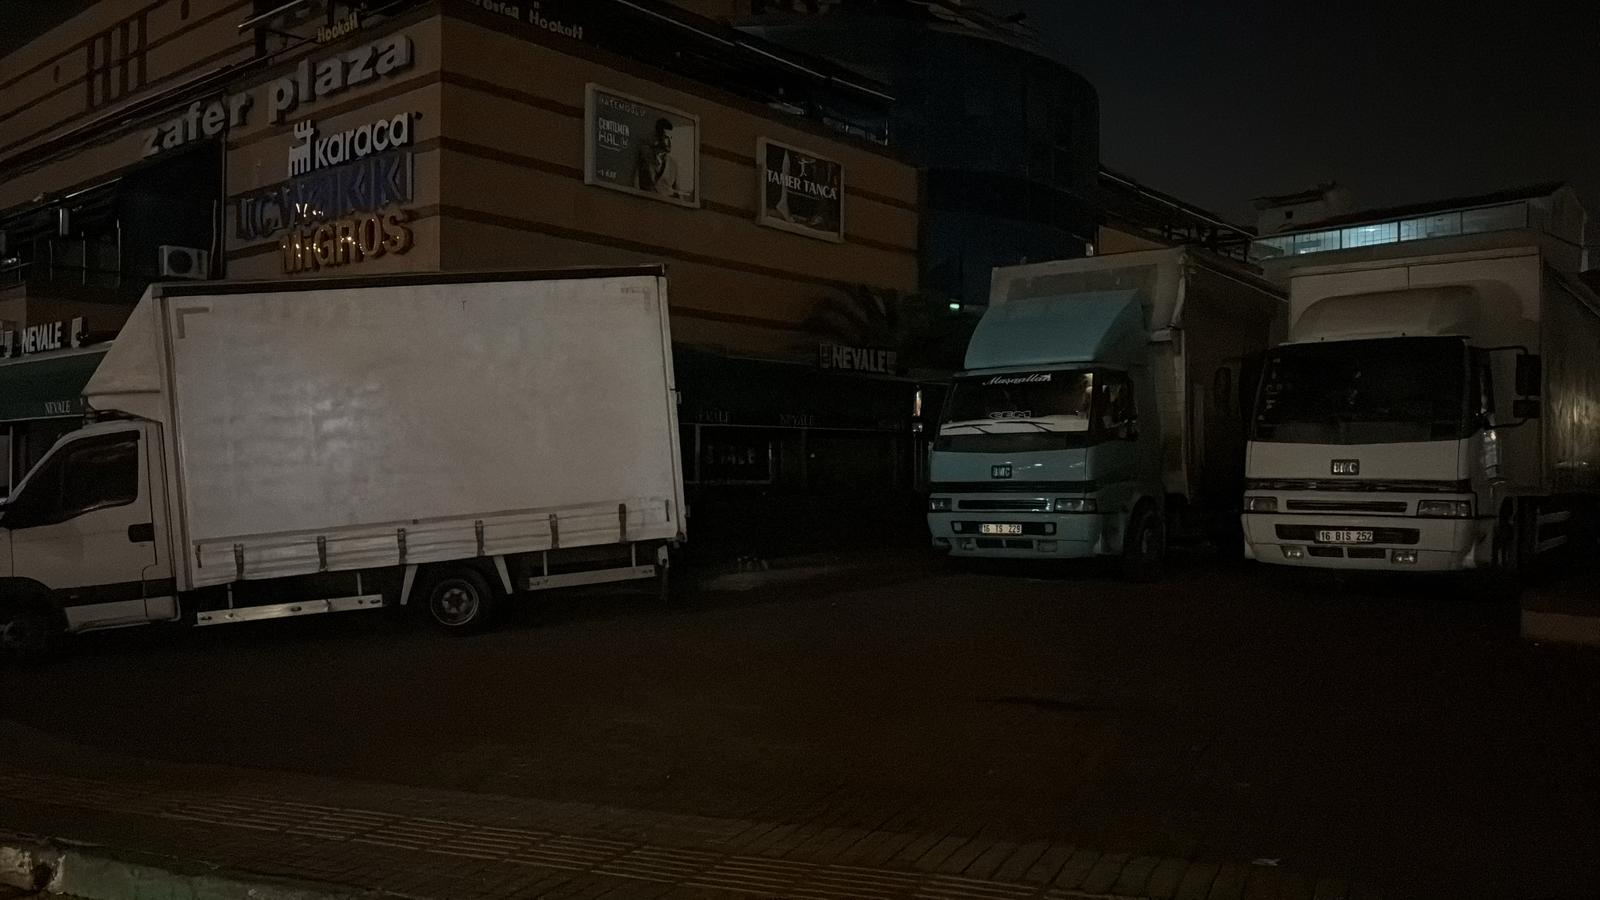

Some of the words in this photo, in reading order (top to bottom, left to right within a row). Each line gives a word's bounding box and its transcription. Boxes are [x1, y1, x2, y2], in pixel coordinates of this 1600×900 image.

[143, 90, 251, 157] zafer
[268, 33, 411, 124] plaza
[314, 112, 412, 170] karaca
[767, 169, 801, 190] TAMER
[802, 179, 838, 200] TANCA
[21, 320, 64, 354] NEVALE
[831, 344, 887, 373] NEVALE
[1321, 531, 1331, 541] 16
[1335, 531, 1352, 541] BIS
[1356, 532, 1372, 541] 252
